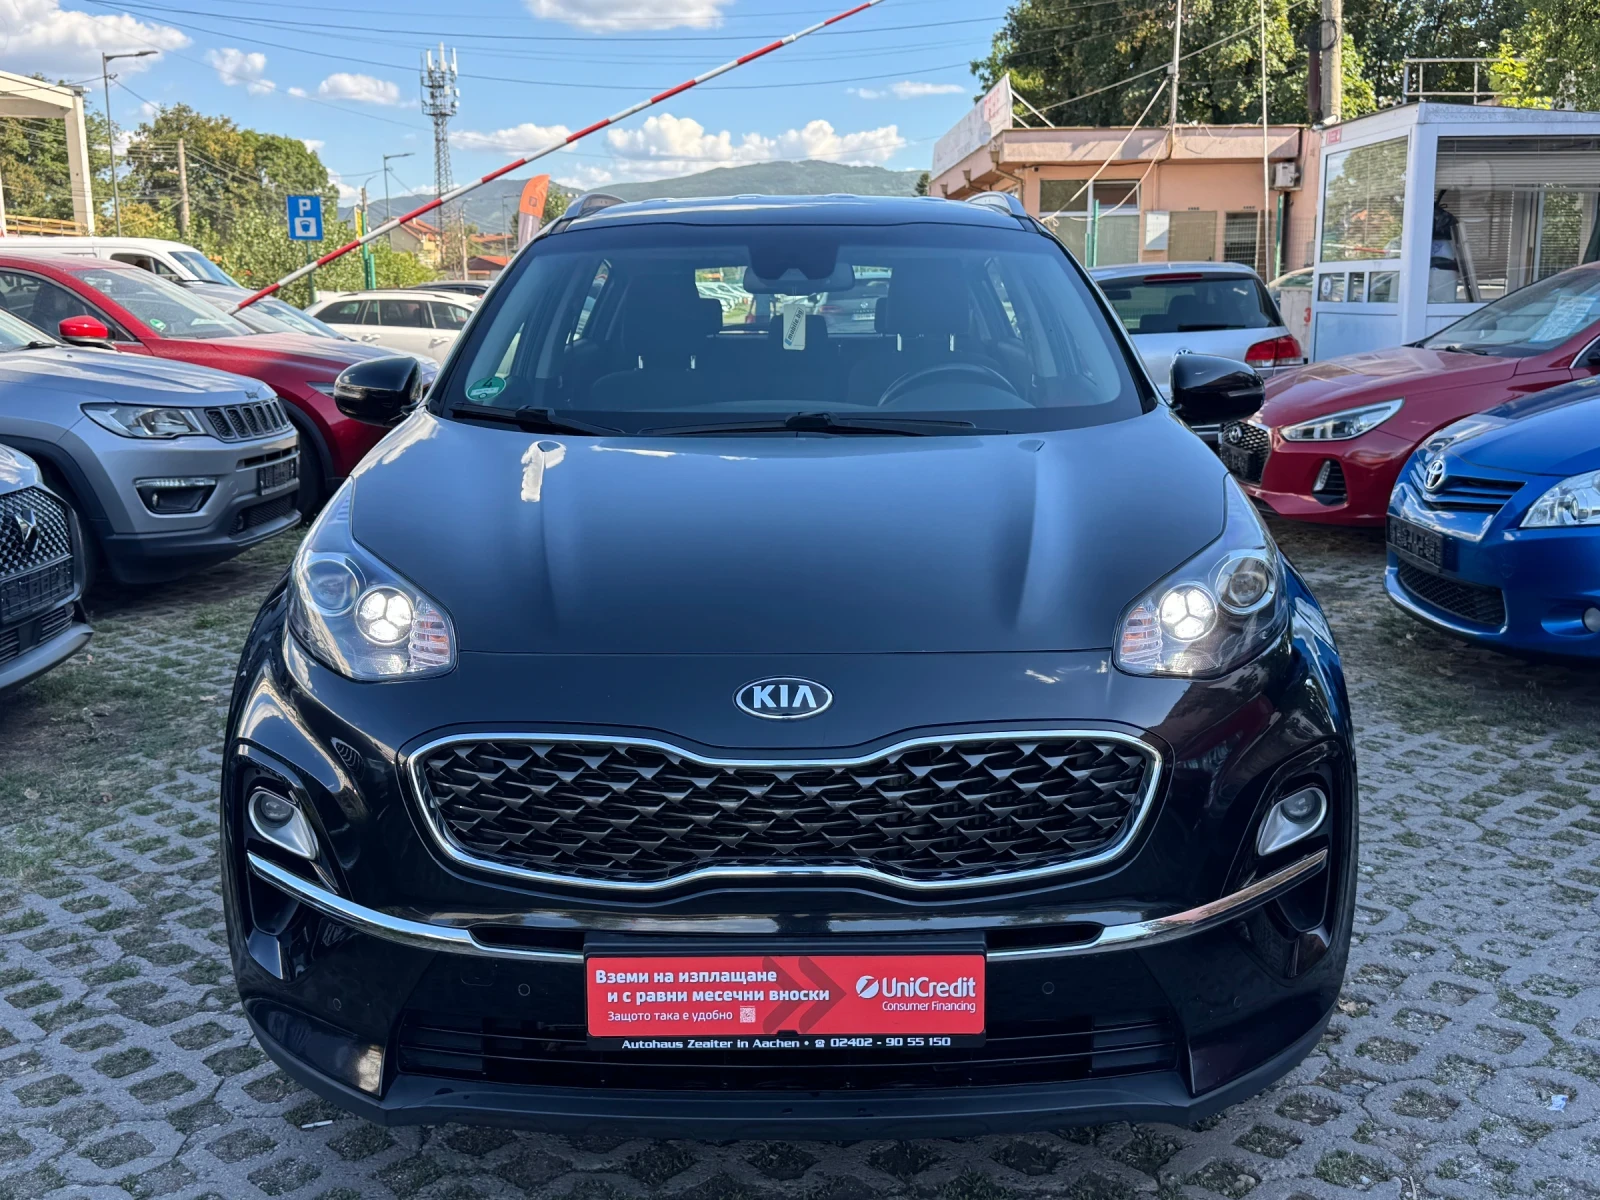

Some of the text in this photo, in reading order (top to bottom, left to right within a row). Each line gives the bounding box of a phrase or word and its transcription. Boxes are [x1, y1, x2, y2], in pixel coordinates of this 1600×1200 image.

[298, 199, 311, 217] P
[787, 308, 804, 341] mobile.bg
[482, 378, 493, 388] 4
[752, 684, 817, 709] KIA
[595, 969, 777, 985] Вземи на изплащане
[882, 976, 976, 998] UniCredit
[607, 989, 830, 1006] и с равни месечни вноски
[882, 1001, 976, 1014] Consumer Financing
[607, 1009, 733, 1023] Защото така е удобно
[621, 1039, 684, 1049] Autohaus
[687, 1039, 733, 1049] Zeaiter
[736, 1039, 749, 1048] in
[752, 1039, 800, 1048] Aachen
[830, 1037, 873, 1047] 02402
[885, 1037, 904, 1047] 90
[907, 1037, 925, 1046] 55
[928, 1037, 951, 1046] 150
